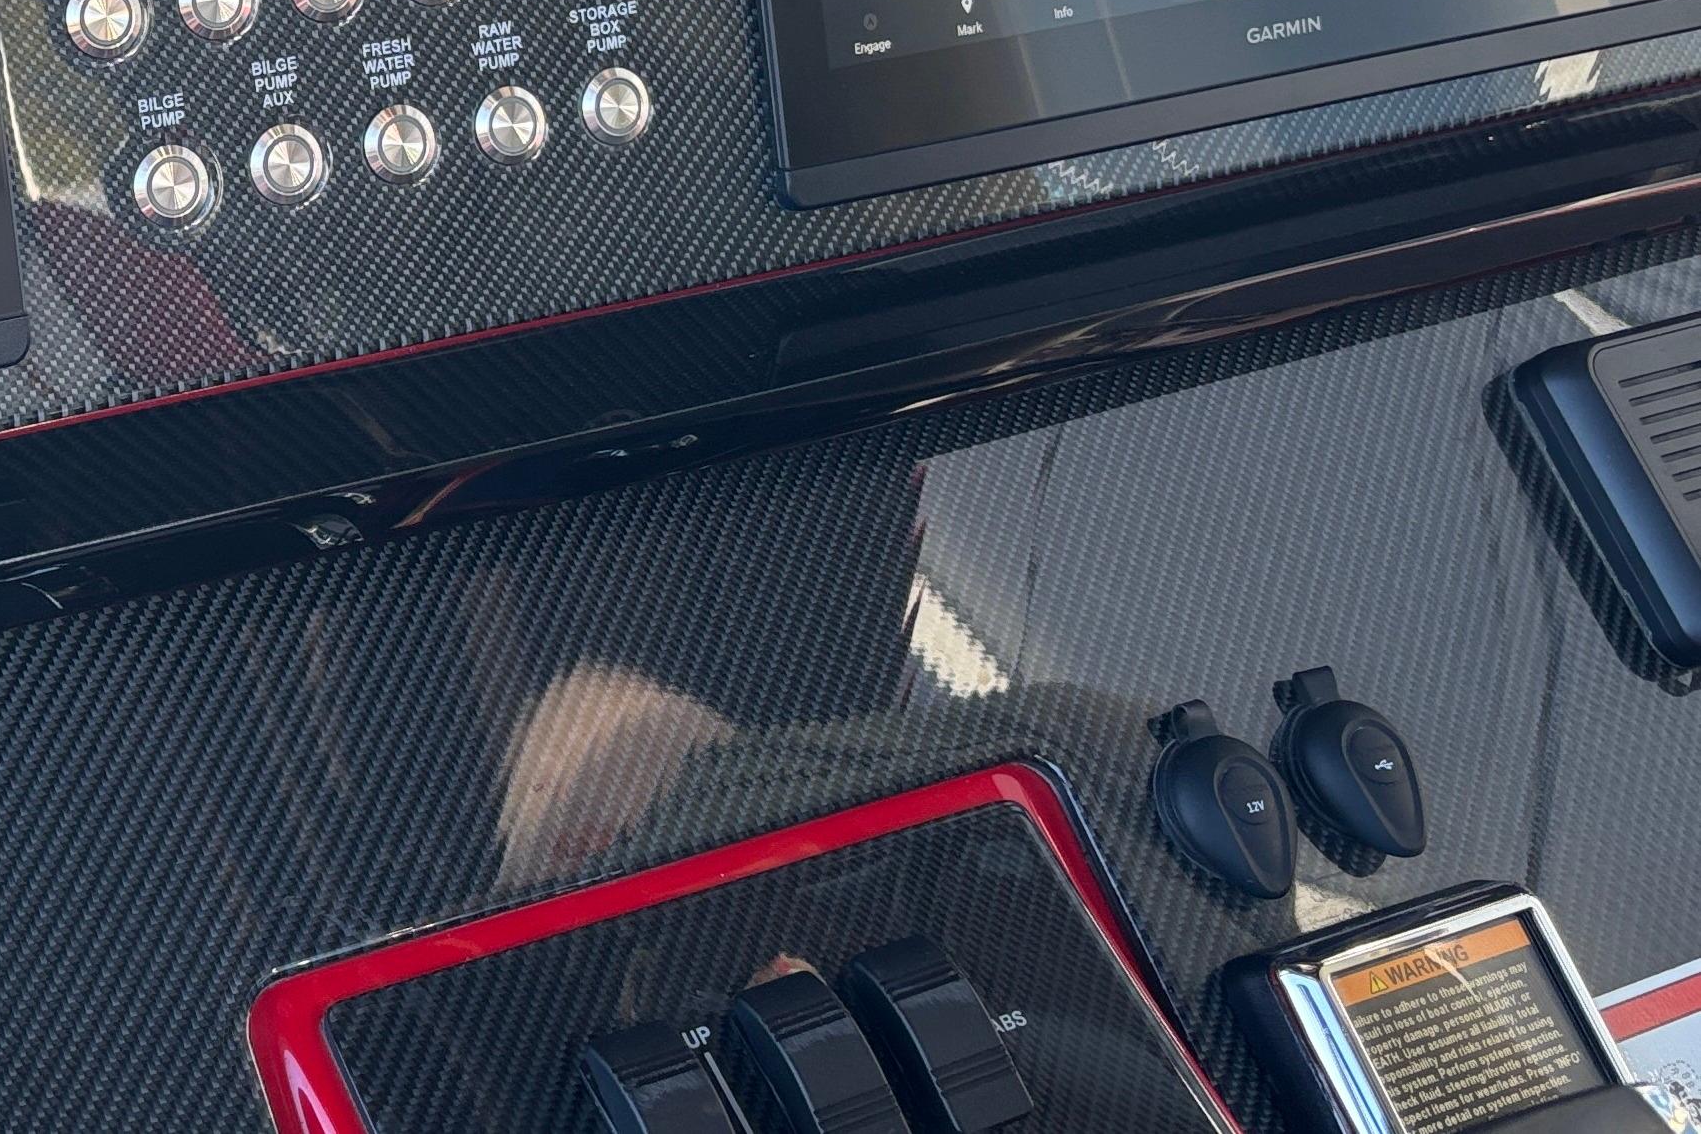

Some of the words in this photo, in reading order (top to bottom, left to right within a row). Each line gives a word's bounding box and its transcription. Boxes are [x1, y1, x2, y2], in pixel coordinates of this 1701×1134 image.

[569, 0, 638, 24] STORAGE
[1054, 5, 1073, 19] Info
[478, 20, 512, 40] RAW
[589, 18, 620, 37] BOX
[957, 21, 983, 36] Mark
[1246, 15, 1322, 44] GARMIN
[362, 38, 412, 57] FRESH
[471, 35, 522, 56] WATER
[586, 35, 627, 53] PUMP
[854, 38, 891, 55] Engage
[251, 55, 297, 77] BILGE
[362, 52, 415, 75] WATER
[478, 52, 520, 71] PUMP
[254, 72, 298, 93] PUMP
[369, 70, 412, 89] PUMP
[138, 92, 185, 114] BILGE
[262, 89, 294, 108] AUX
[141, 109, 185, 130] PUMP
[1247, 800, 1264, 814] 12V
[1381, 1008, 1392, 1018] to
[1394, 996, 1426, 1014] adhere
[1427, 992, 1438, 1002] to
[1440, 982, 1468, 998] these
[1468, 968, 1508, 988] warnings
[1509, 962, 1527, 973] may
[1383, 1023, 1394, 1034] in
[1393, 1016, 1415, 1030] loss
[1416, 1011, 1426, 1022] of
[1426, 1004, 1449, 1019] boat
[1443, 1007, 1483, 1032] personal
[1520, 992, 1531, 1002] or
[682, 1026, 711, 1050] UP
[1402, 1045, 1426, 1059] User
[1428, 1030, 1468, 1051] assumes
[1469, 1023, 1480, 1036] all
[1516, 1003, 1539, 1019] total
[1440, 1048, 1458, 1063] and
[1458, 1042, 1481, 1056] risks
[1482, 1027, 1516, 1048] related
[1515, 1026, 1526, 1035] to
[1527, 1016, 1554, 1032] using
[1402, 1074, 1439, 1093] system.
[1438, 1059, 1478, 1078] Perform
[1479, 1046, 1513, 1065] system
[1513, 1029, 1563, 1052] inspection.
[1431, 1099, 1460, 1115] items
[1459, 1093, 1475, 1104] for
[1526, 1064, 1555, 1081] Press
[1419, 1121, 1443, 1134] more
[1445, 1108, 1472, 1127] detail
[1473, 1105, 1487, 1115] on
[1486, 1092, 1520, 1112] system
[1520, 1075, 1571, 1099] inspection.
